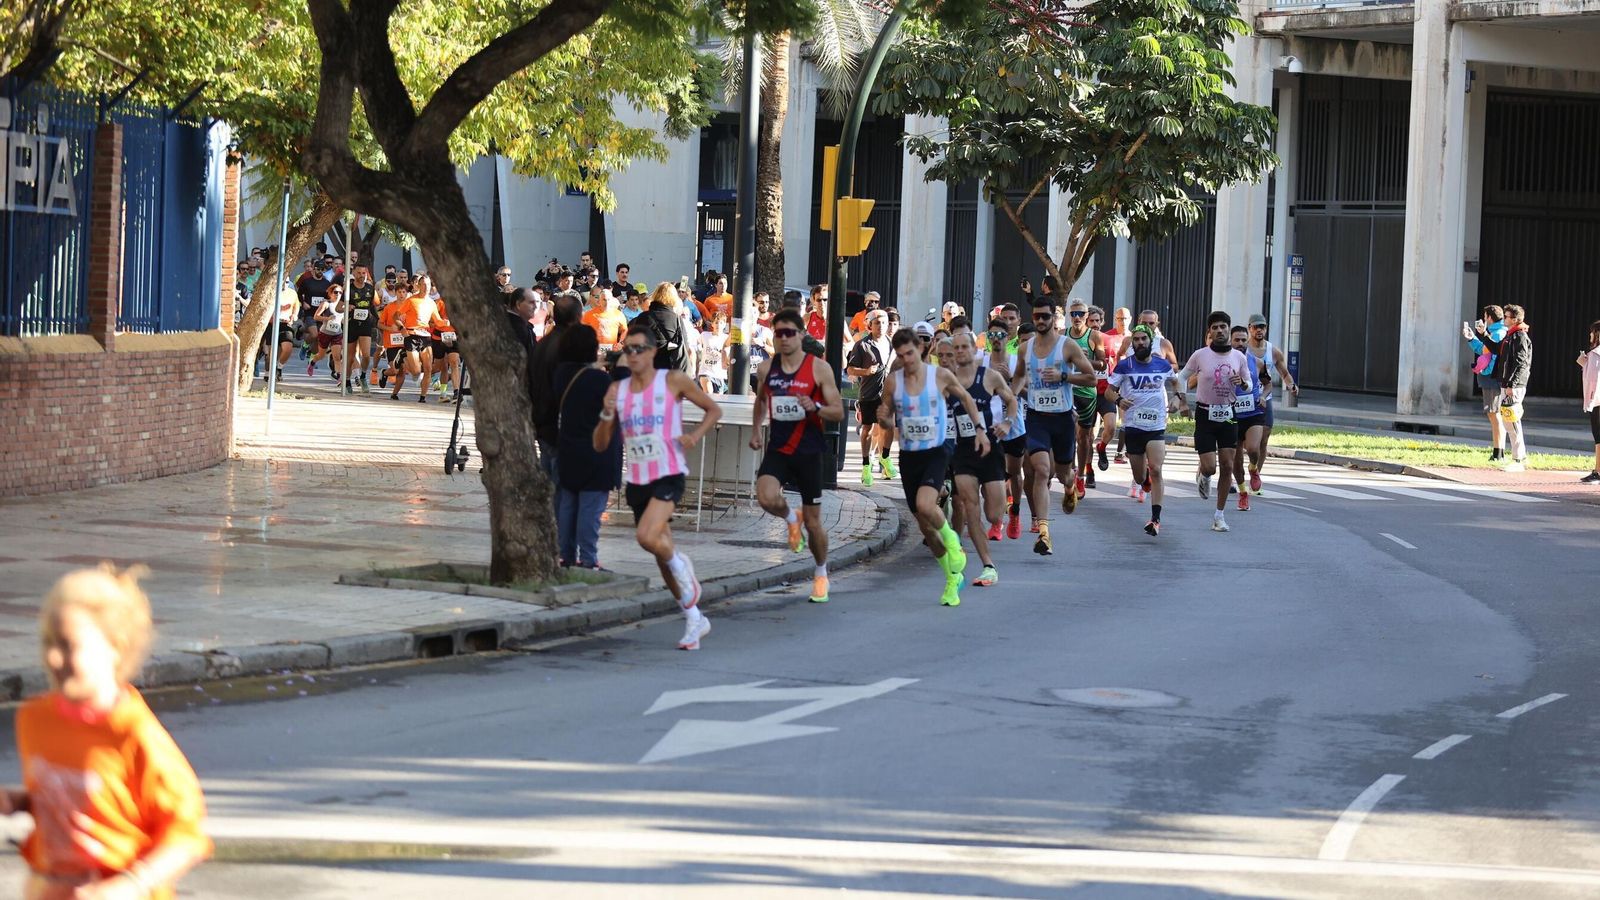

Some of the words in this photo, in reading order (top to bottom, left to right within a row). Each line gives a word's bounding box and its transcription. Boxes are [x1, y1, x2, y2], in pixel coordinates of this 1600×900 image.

[0, 131, 77, 216] PIA
[1292, 257, 1303, 265] BUS
[1129, 375, 1162, 390] VAS
[1038, 396, 1057, 405] 870
[1234, 400, 1251, 408] 448
[776, 404, 798, 413] 694
[1138, 413, 1158, 421] 1029
[1212, 410, 1229, 418] 324
[907, 425, 930, 434] 330
[631, 444, 653, 456] 117
